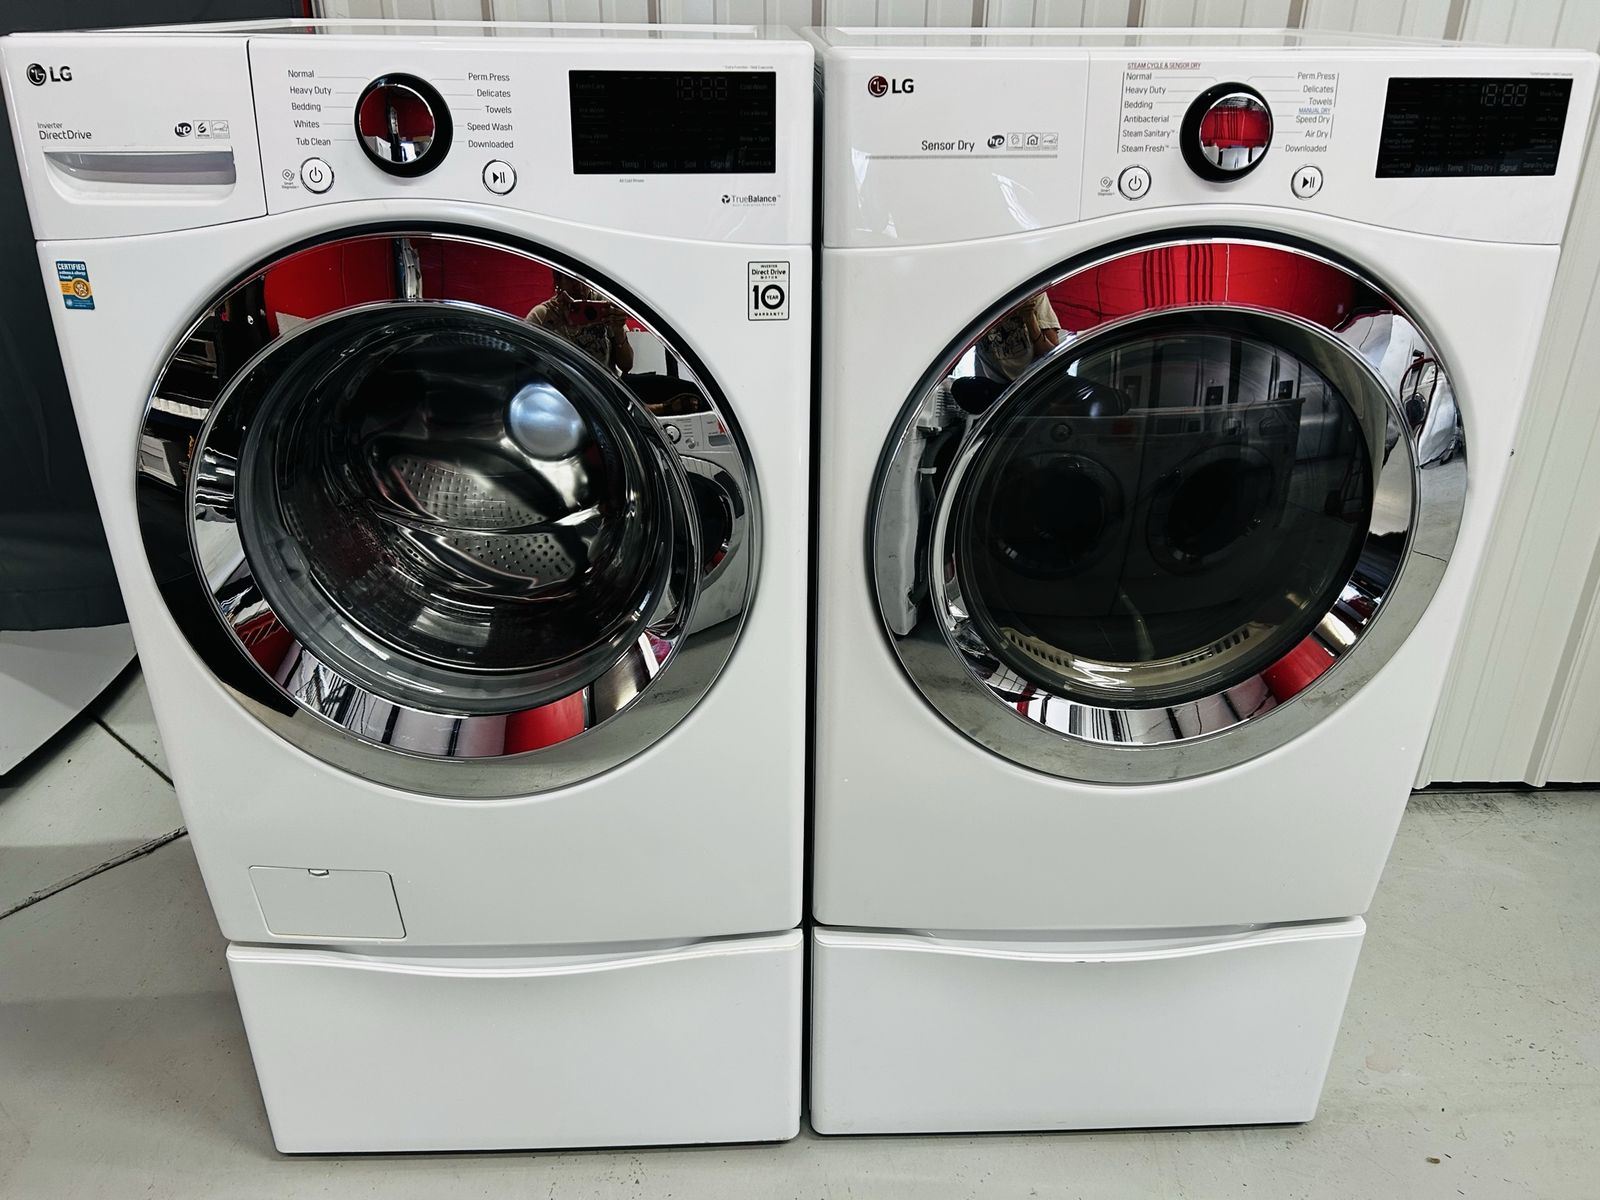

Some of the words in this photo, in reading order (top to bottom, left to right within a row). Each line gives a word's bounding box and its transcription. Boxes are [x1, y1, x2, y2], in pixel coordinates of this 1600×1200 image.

[49, 65, 72, 82] LG
[287, 69, 314, 78] Normal
[468, 72, 488, 80] Perm
[489, 72, 510, 81] Press
[1126, 72, 1152, 80] Normal
[1297, 71, 1316, 80] Perm
[1316, 71, 1335, 80] Press
[891, 78, 914, 94] LG
[1125, 86, 1148, 95] Heavy
[1149, 86, 1166, 95] Duty
[1303, 84, 1334, 93] Delicates
[289, 86, 312, 95] Heavy
[314, 86, 332, 96] Duty
[476, 88, 511, 97] Delicates
[1124, 100, 1153, 109] Bedding
[1309, 97, 1333, 105] Towels
[291, 102, 321, 112] Bedding
[485, 105, 512, 114] Towels
[1123, 115, 1169, 123] Antibacterial
[1295, 115, 1317, 124] Speed
[1318, 115, 1330, 124] Dry
[37, 121, 63, 129] Inverter
[293, 120, 320, 128] Whites
[467, 122, 490, 132] Speed
[491, 122, 513, 131] Wash
[1122, 129, 1143, 137] Steam
[1305, 129, 1316, 138] Air
[1316, 129, 1328, 138] Dry
[296, 137, 309, 146] Tub
[310, 137, 331, 146] Clean
[468, 139, 514, 148] Downloaded
[921, 139, 955, 151] Sensor
[957, 139, 975, 152] Dry
[1121, 144, 1144, 152] Steam
[1285, 144, 1327, 152] Downloaded
[57, 263, 85, 271] CERTIFIED
[752, 283, 785, 310] 10
